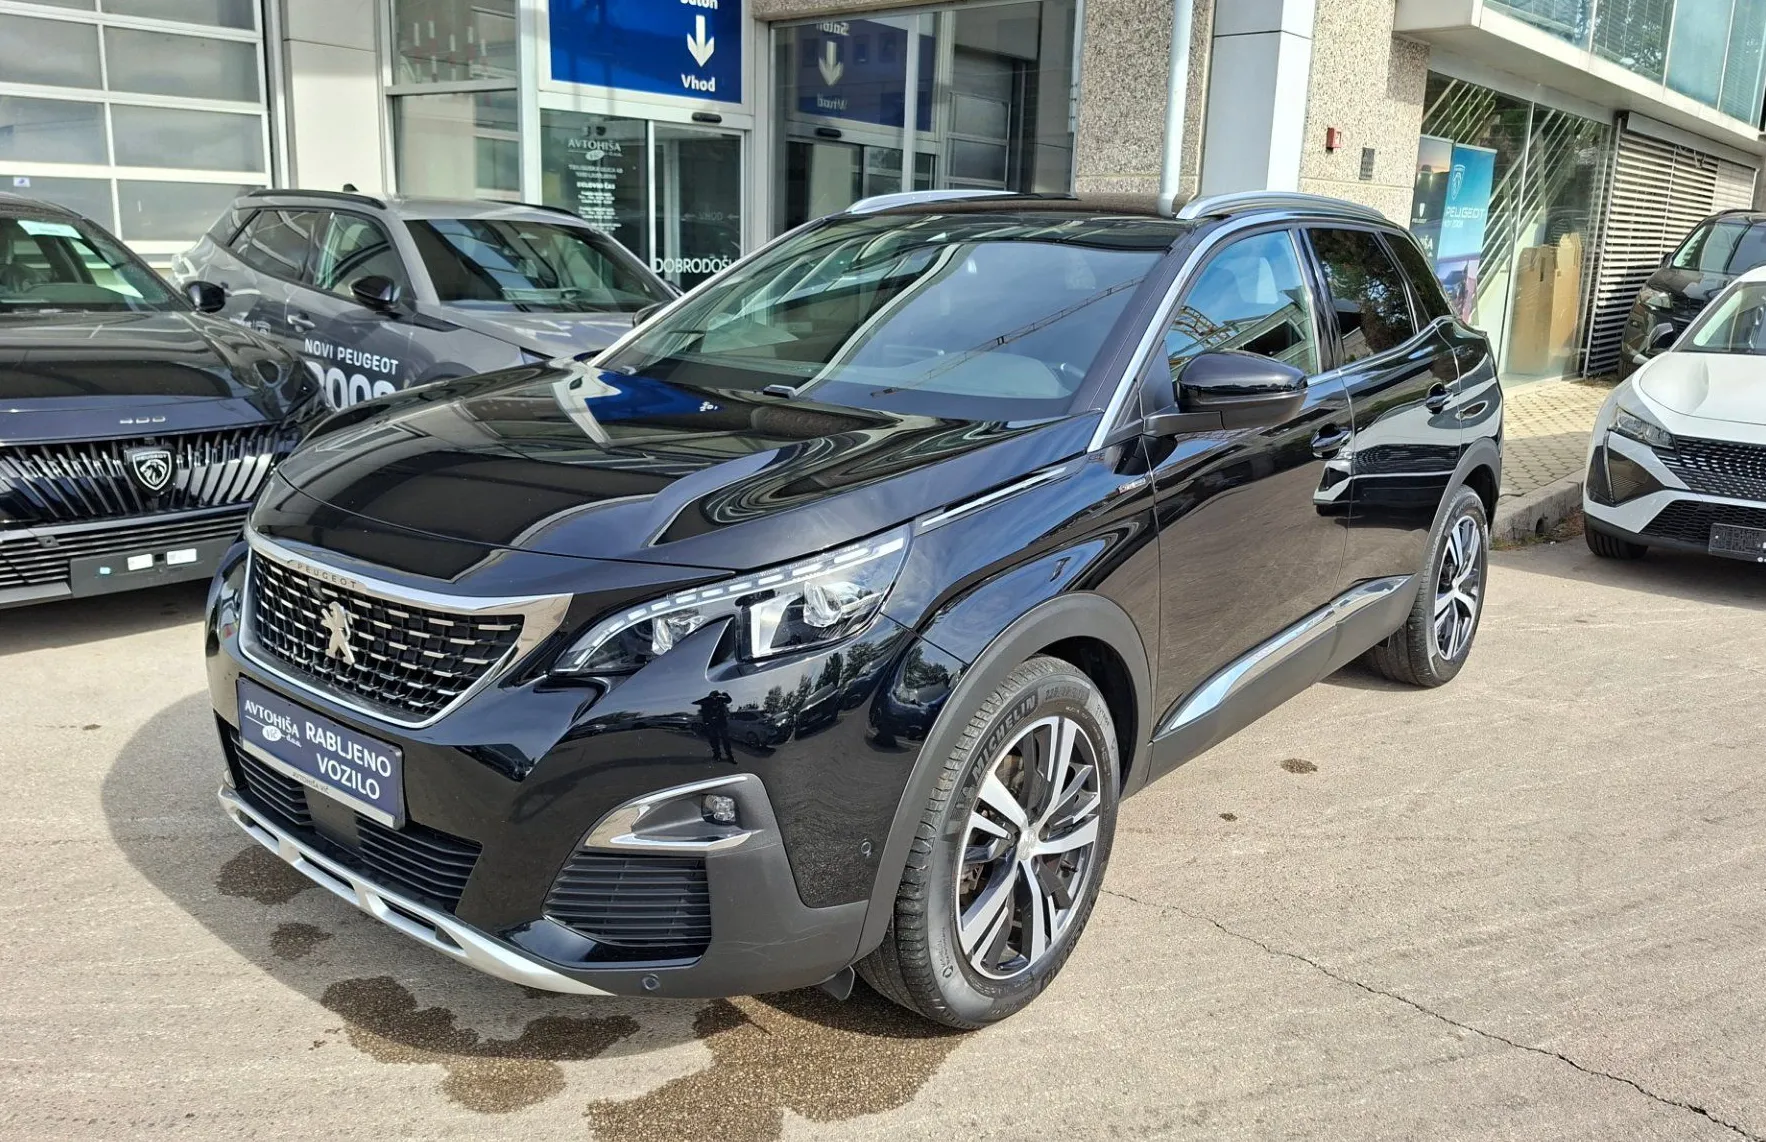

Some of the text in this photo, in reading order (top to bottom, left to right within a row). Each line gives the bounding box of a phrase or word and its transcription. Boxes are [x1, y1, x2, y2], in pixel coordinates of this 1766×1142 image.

[681, 73, 716, 92] Vhod
[567, 139, 621, 151] AVTOHIŠA
[1444, 206, 1485, 219] PEUGEOT
[654, 254, 737, 274] DOBRODOŠ
[304, 338, 399, 375] NOVI PEUGEOT
[297, 562, 356, 589] PEUGEOT
[244, 699, 391, 778] AVTOHIŠA RABLJENO
[971, 694, 1036, 781] MICHELIN
[316, 753, 380, 800] VOZILO
